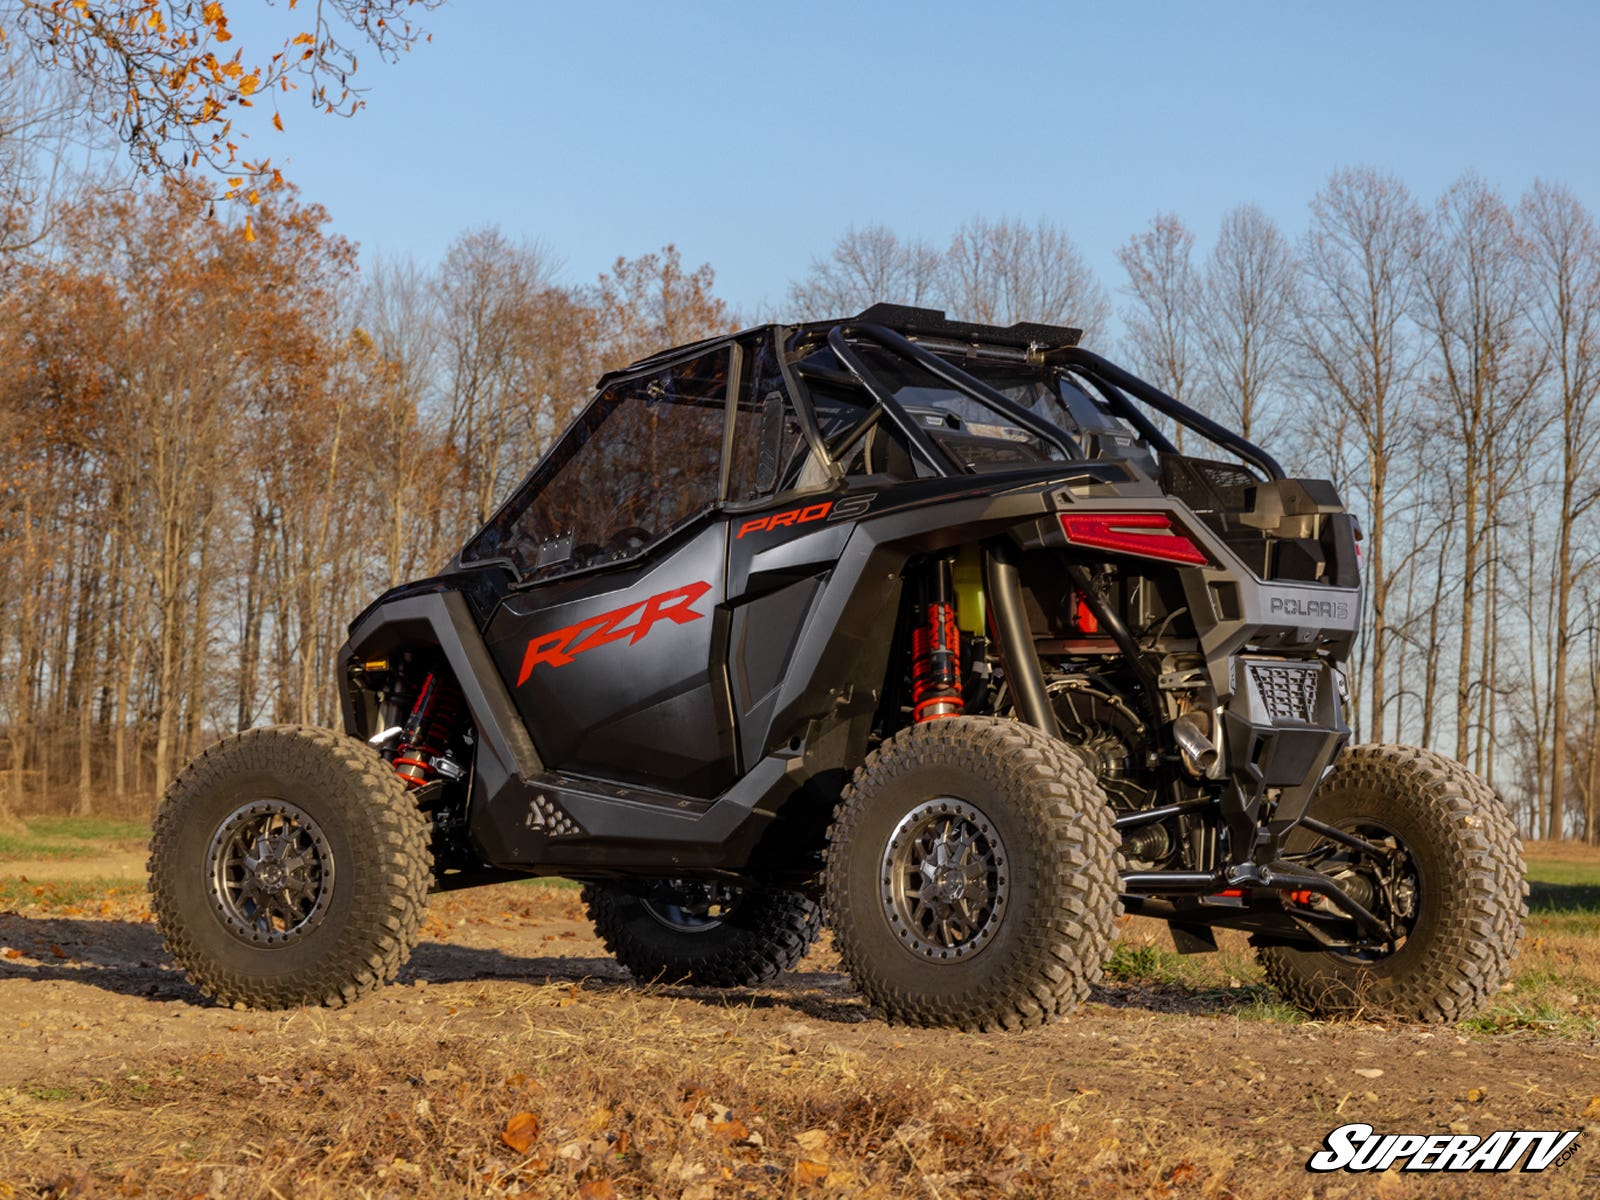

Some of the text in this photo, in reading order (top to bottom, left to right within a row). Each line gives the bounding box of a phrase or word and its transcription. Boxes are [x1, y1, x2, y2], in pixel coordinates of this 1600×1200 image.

[736, 501, 833, 540] PRO
[1270, 597, 1349, 620] POLARIS
[516, 580, 713, 689] RZR
